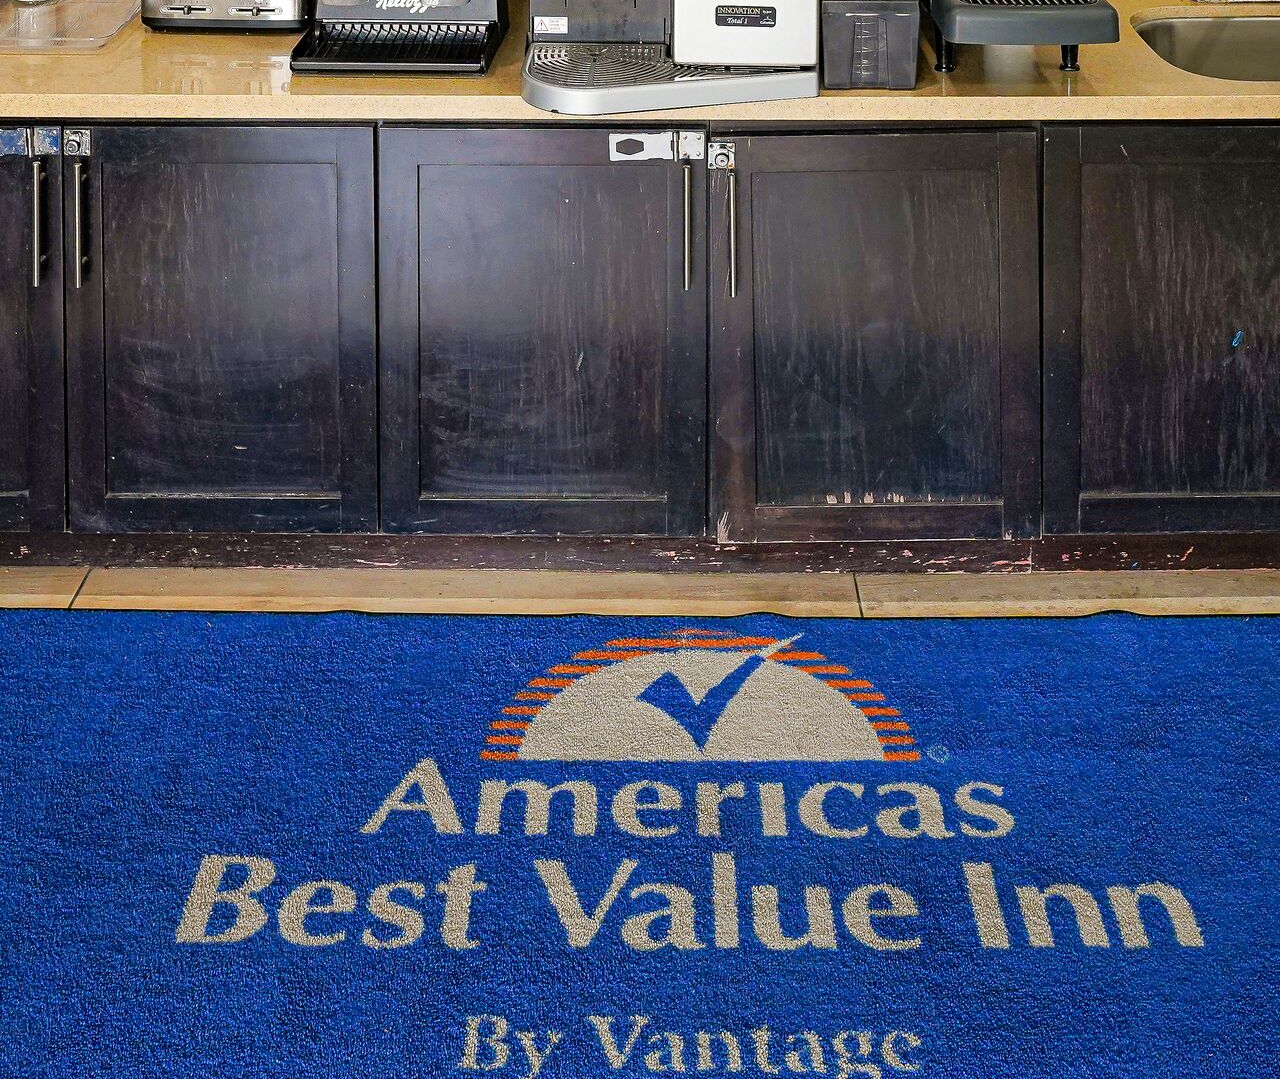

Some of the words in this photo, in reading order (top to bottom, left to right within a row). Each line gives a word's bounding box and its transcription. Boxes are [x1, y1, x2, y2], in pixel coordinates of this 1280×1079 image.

[358, 757, 1016, 839] Americas
[174, 854, 488, 950] Best
[532, 851, 923, 952] Value
[961, 861, 1206, 950] Inn
[456, 1014, 564, 1079] By
[587, 1014, 923, 1079] Vantage
